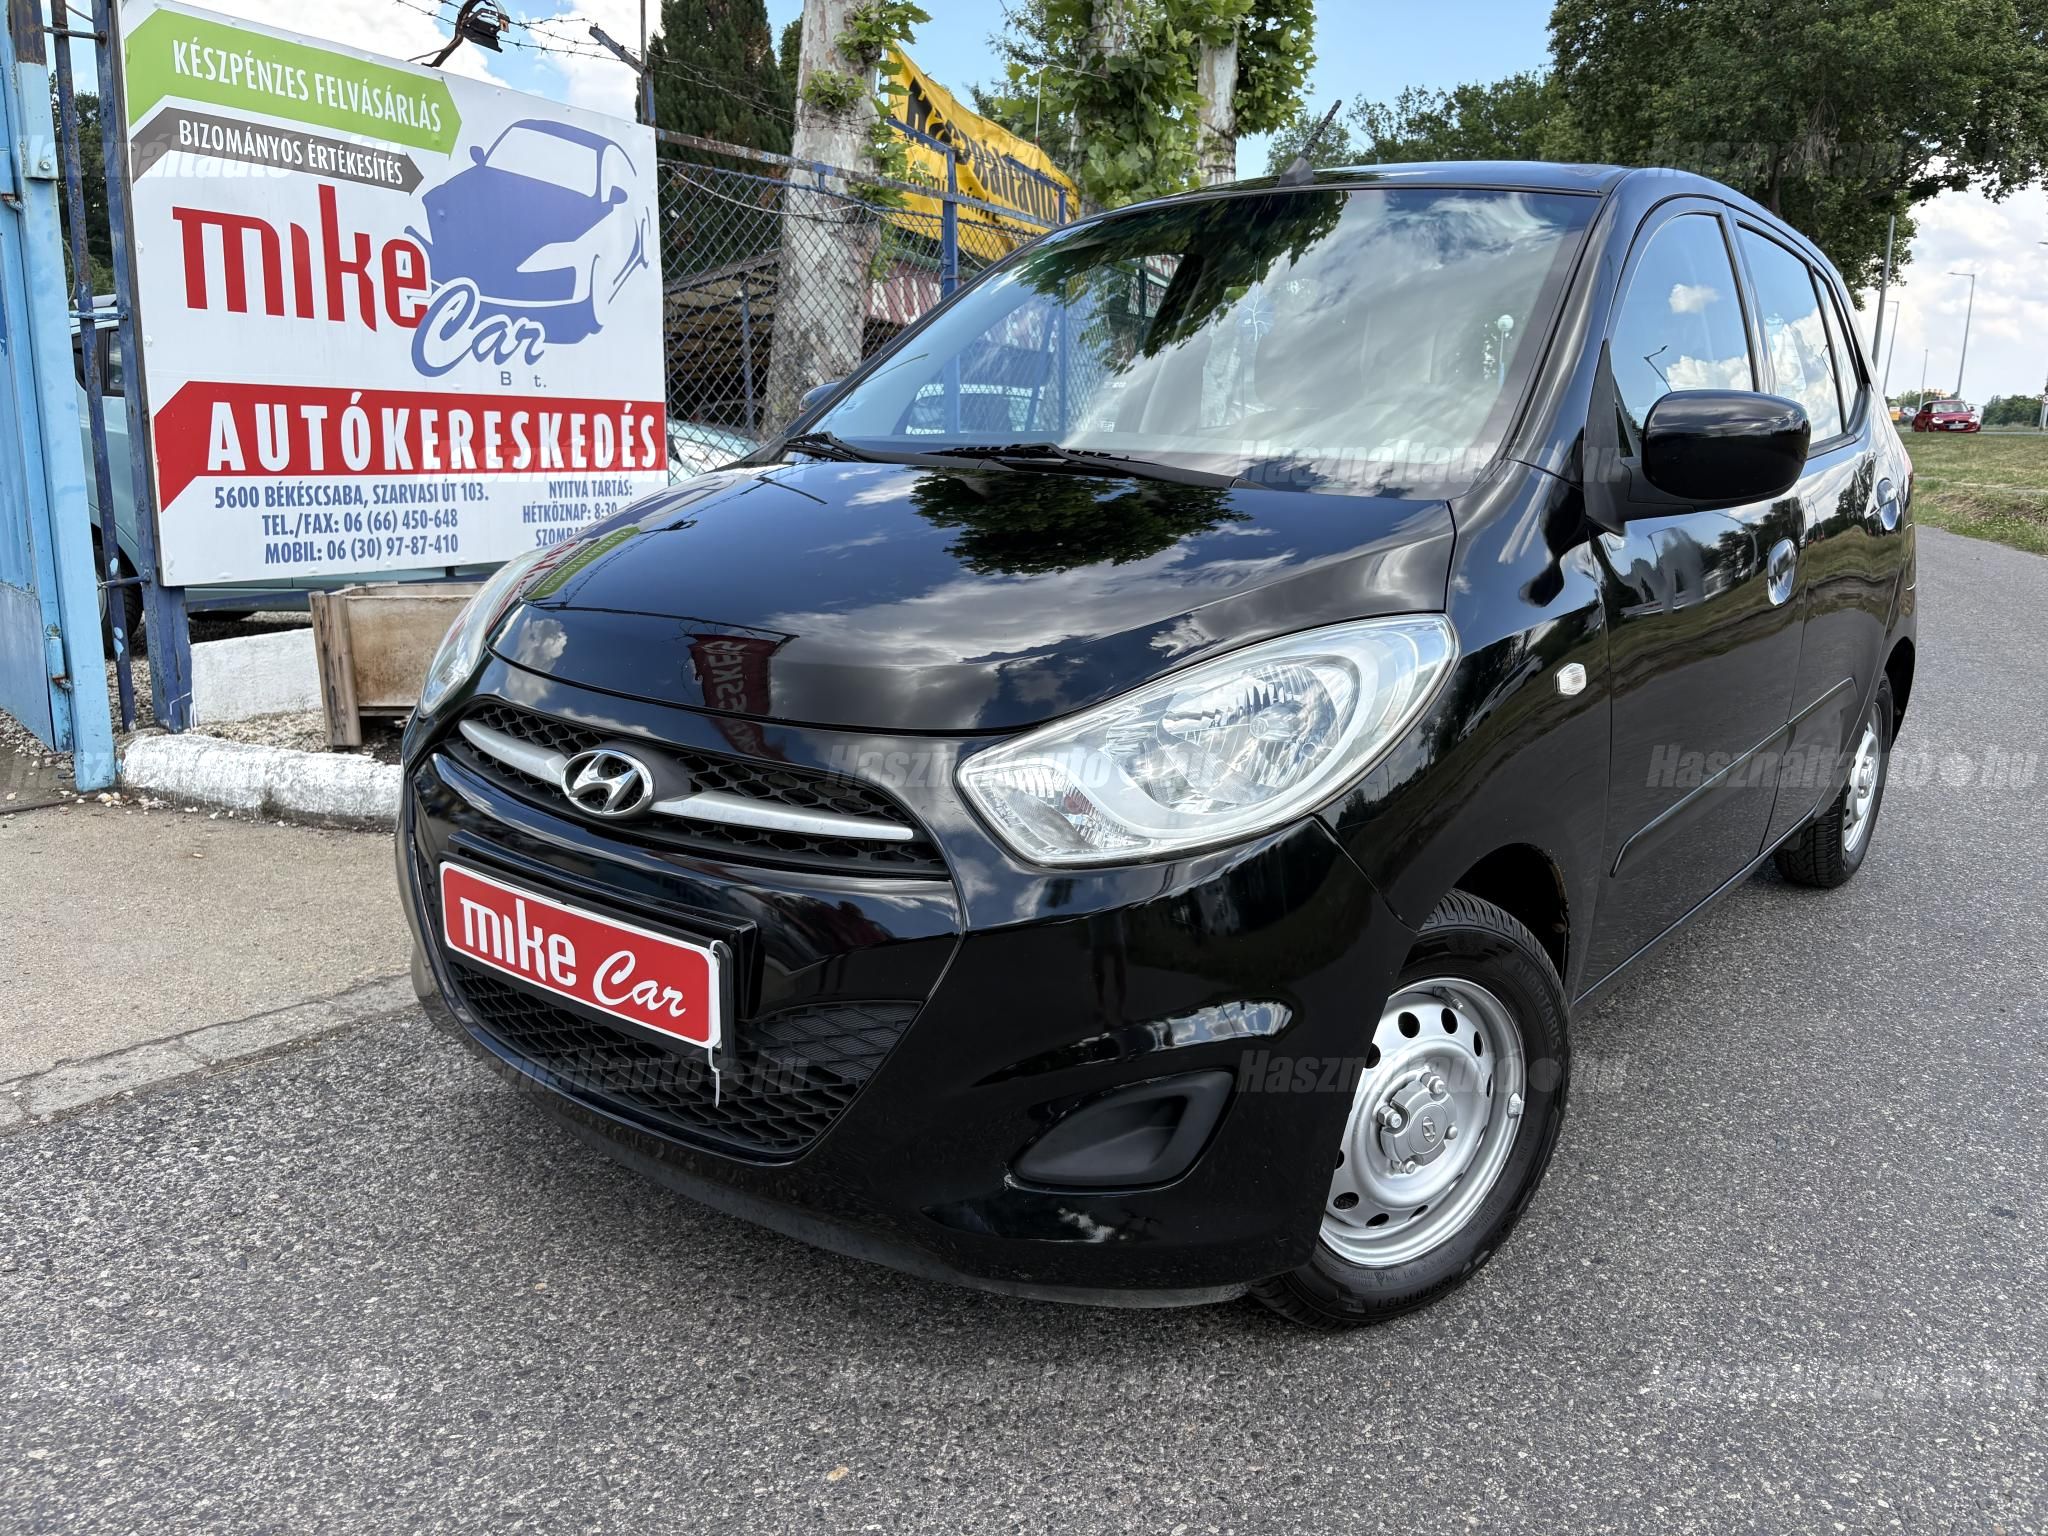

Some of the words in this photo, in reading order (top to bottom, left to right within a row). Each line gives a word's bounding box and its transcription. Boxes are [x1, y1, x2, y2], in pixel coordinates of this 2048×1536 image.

[172, 37, 309, 100] KÉSZPÉNZES
[314, 73, 441, 133] FELVÁSÁRLÁS
[179, 119, 303, 165] BIZOMÁNYOS
[308, 138, 403, 185] ÉRTÉKESÍTÉS
[172, 183, 428, 332] mike
[411, 282, 545, 378] Car
[207, 391, 656, 472] AUTÓKERESKEDÉS
[214, 486, 259, 509] 5600
[264, 481, 369, 509] BÉKÉSCSABA,
[373, 482, 439, 505] SZARVASI
[441, 478, 456, 502] ÚT
[460, 482, 489, 502] 103.
[523, 501, 591, 523] HÉTKÖZNAP:
[549, 480, 589, 498] NYITVA
[592, 475, 633, 497] TARTÁS:
[262, 512, 339, 538] TEL./FAX:
[343, 511, 363, 532] 06
[367, 510, 397, 534] (66)
[402, 508, 458, 530] 450-648
[265, 541, 323, 564] MOBIL:
[327, 539, 347, 560] 06
[351, 537, 382, 562] (30)
[386, 534, 458, 556] 97-87-410
[460, 896, 577, 987] mike
[592, 950, 687, 1018] Car
